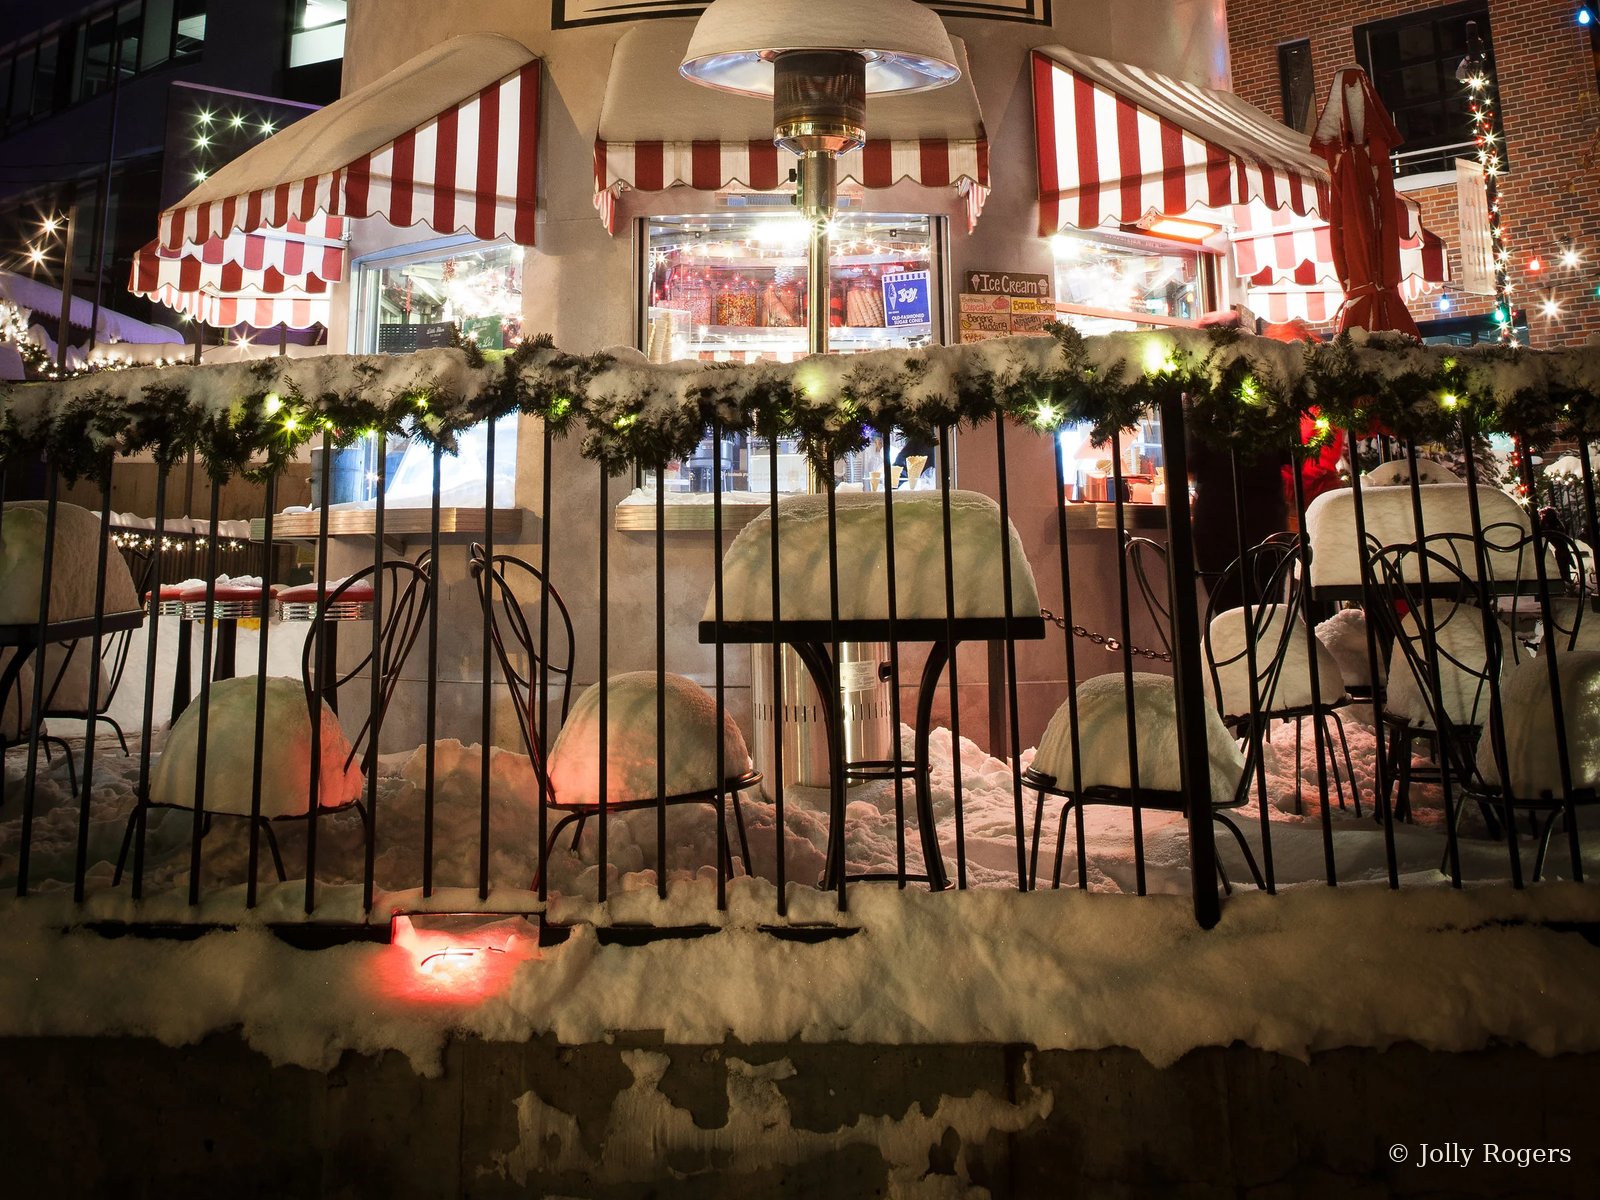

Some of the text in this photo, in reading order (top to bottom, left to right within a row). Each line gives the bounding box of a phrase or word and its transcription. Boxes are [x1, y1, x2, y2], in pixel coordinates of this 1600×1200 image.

[980, 274, 1000, 292] Ice
[966, 314, 993, 324] Banana
[978, 321, 1008, 333] Pudding
